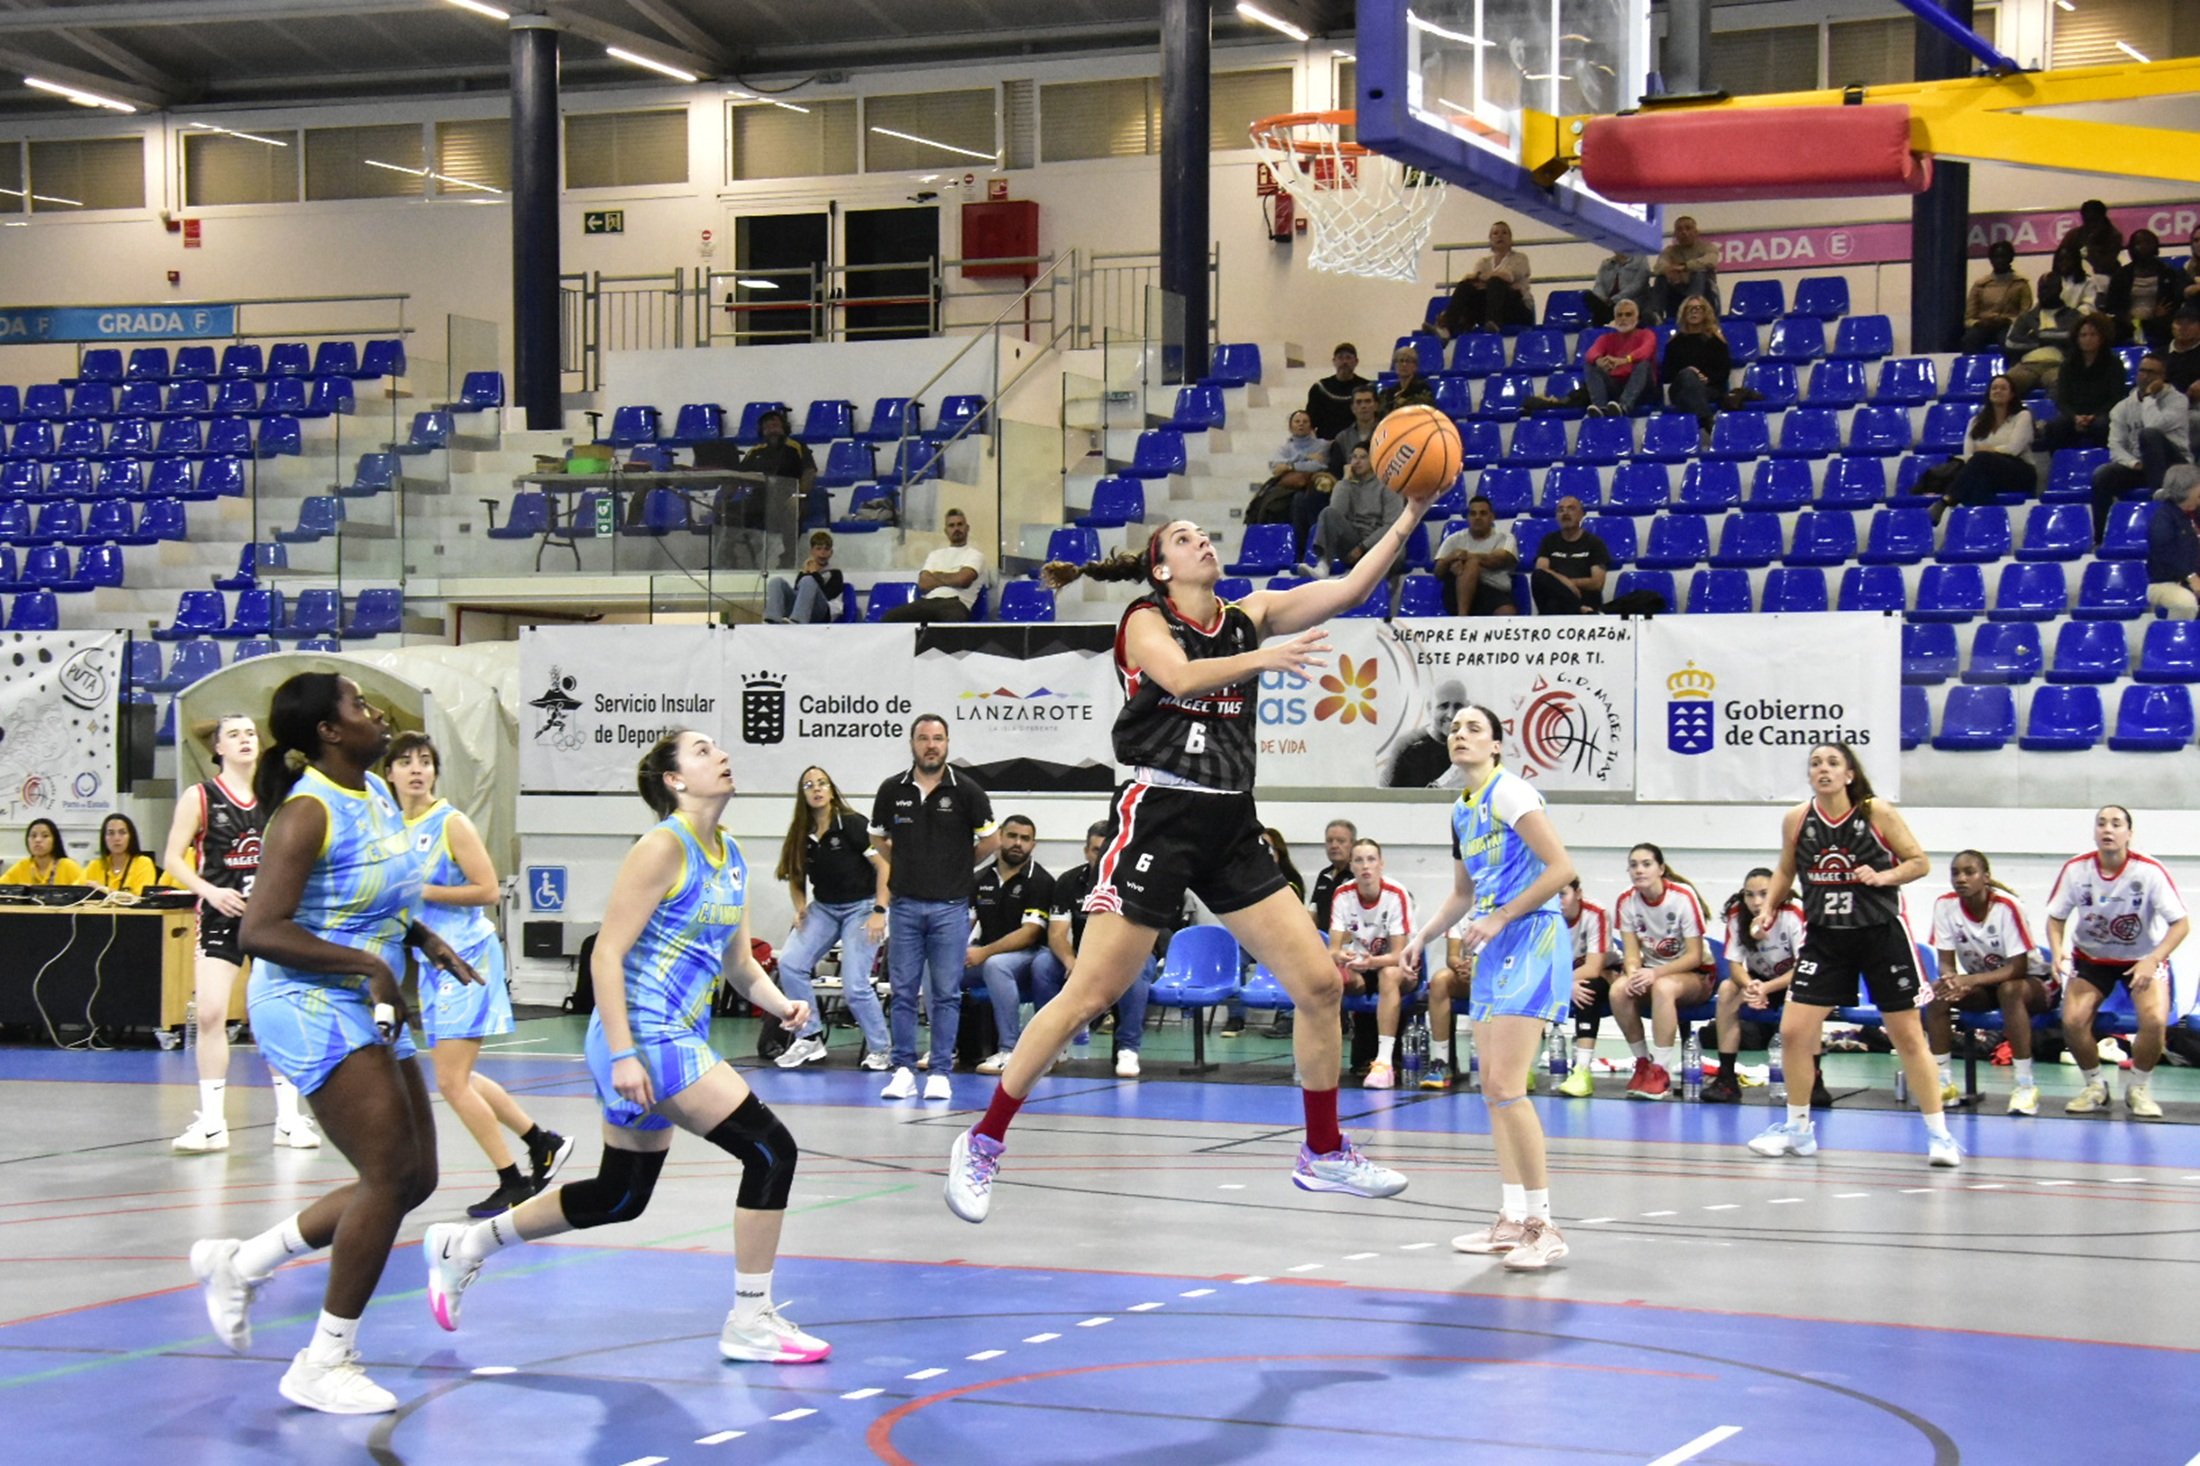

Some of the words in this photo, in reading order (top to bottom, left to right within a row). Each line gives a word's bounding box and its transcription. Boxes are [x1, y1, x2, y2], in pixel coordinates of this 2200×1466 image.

[1966, 221, 2039, 248] ADA
[98, 312, 184, 334] GRADA
[194, 312, 208, 330] F
[1392, 628, 1454, 643] SIEMPRE
[1460, 628, 1478, 642] EN
[1484, 627, 1550, 643] NUESTRO
[1417, 652, 1451, 665] ESTE
[1456, 651, 1520, 666] PARTIDO
[1526, 652, 1544, 666] VA
[1549, 651, 1579, 666] POR
[594, 693, 657, 713] Servicio
[661, 693, 716, 713] Insular
[798, 694, 888, 715] Cabildo
[894, 695, 912, 714] de
[956, 705, 1093, 721] LANZAROTE
[1724, 698, 1844, 721] Gobierno
[594, 724, 613, 744] de
[798, 719, 903, 738] Lanzarote
[1184, 721, 1207, 755] 6
[1724, 724, 1754, 746] de
[1758, 724, 1871, 746] Canarias
[1260, 739, 1276, 754] DE
[1279, 737, 1308, 755] VIDA
[1135, 852, 1155, 873] 6
[1823, 891, 1854, 915] 23
[1797, 960, 1818, 975] 23
